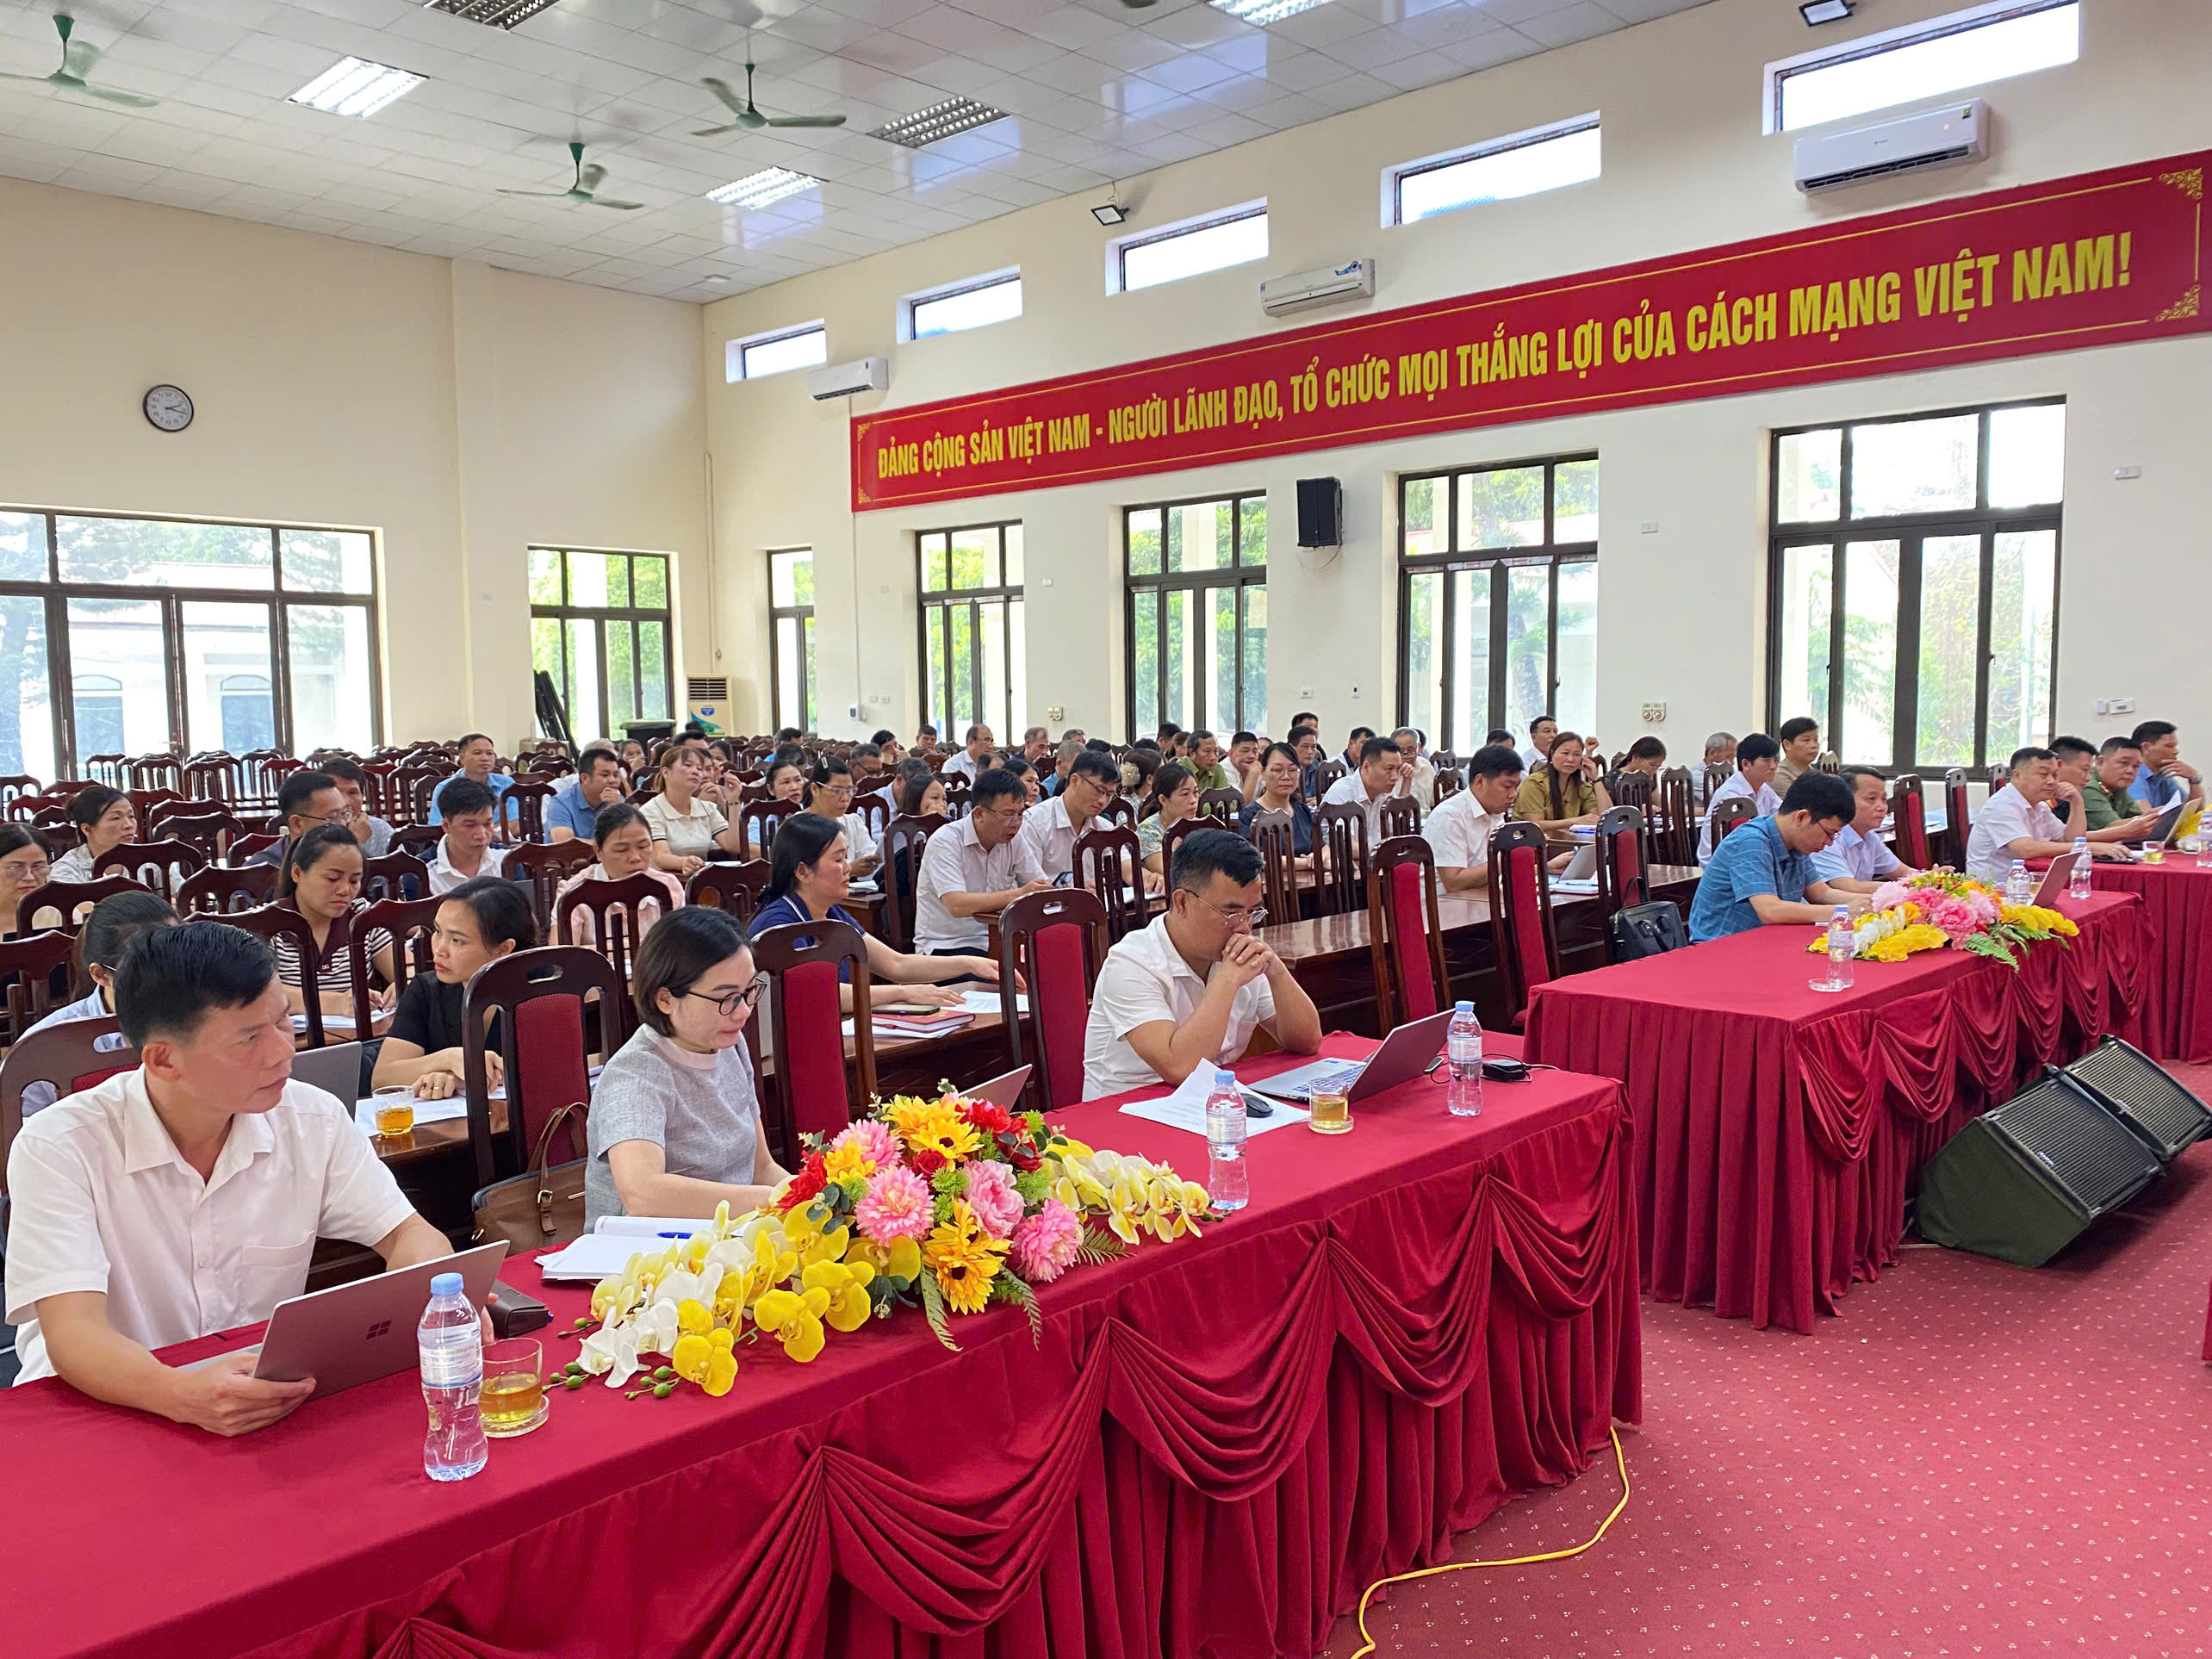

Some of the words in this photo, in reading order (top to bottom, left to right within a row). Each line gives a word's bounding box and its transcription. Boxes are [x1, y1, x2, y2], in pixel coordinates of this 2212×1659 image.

[878, 436, 919, 479] ĐẢNG
[923, 432, 965, 476] CỘNG
[970, 419, 1003, 465] SẢN
[1008, 415, 1043, 464] VIỆT
[1048, 413, 1090, 452] NAM
[1109, 396, 1168, 444] NGƯỜI
[1173, 388, 1227, 434] LÃNH
[1233, 380, 1283, 430] ĐẠO,
[1290, 356, 1319, 414] TỔ
[1327, 352, 1390, 408] CHỨC
[1398, 348, 1448, 401] MỌI
[1456, 322, 1548, 387] THẮNG
[1557, 318, 1603, 379] LỢI
[1612, 298, 1676, 363] CỦA
[1687, 290, 1777, 353] CÁCH
[1789, 272, 1901, 342] MẠNG
[1914, 247, 1999, 323] VIỆT
[2012, 232, 2131, 302] NAM!
